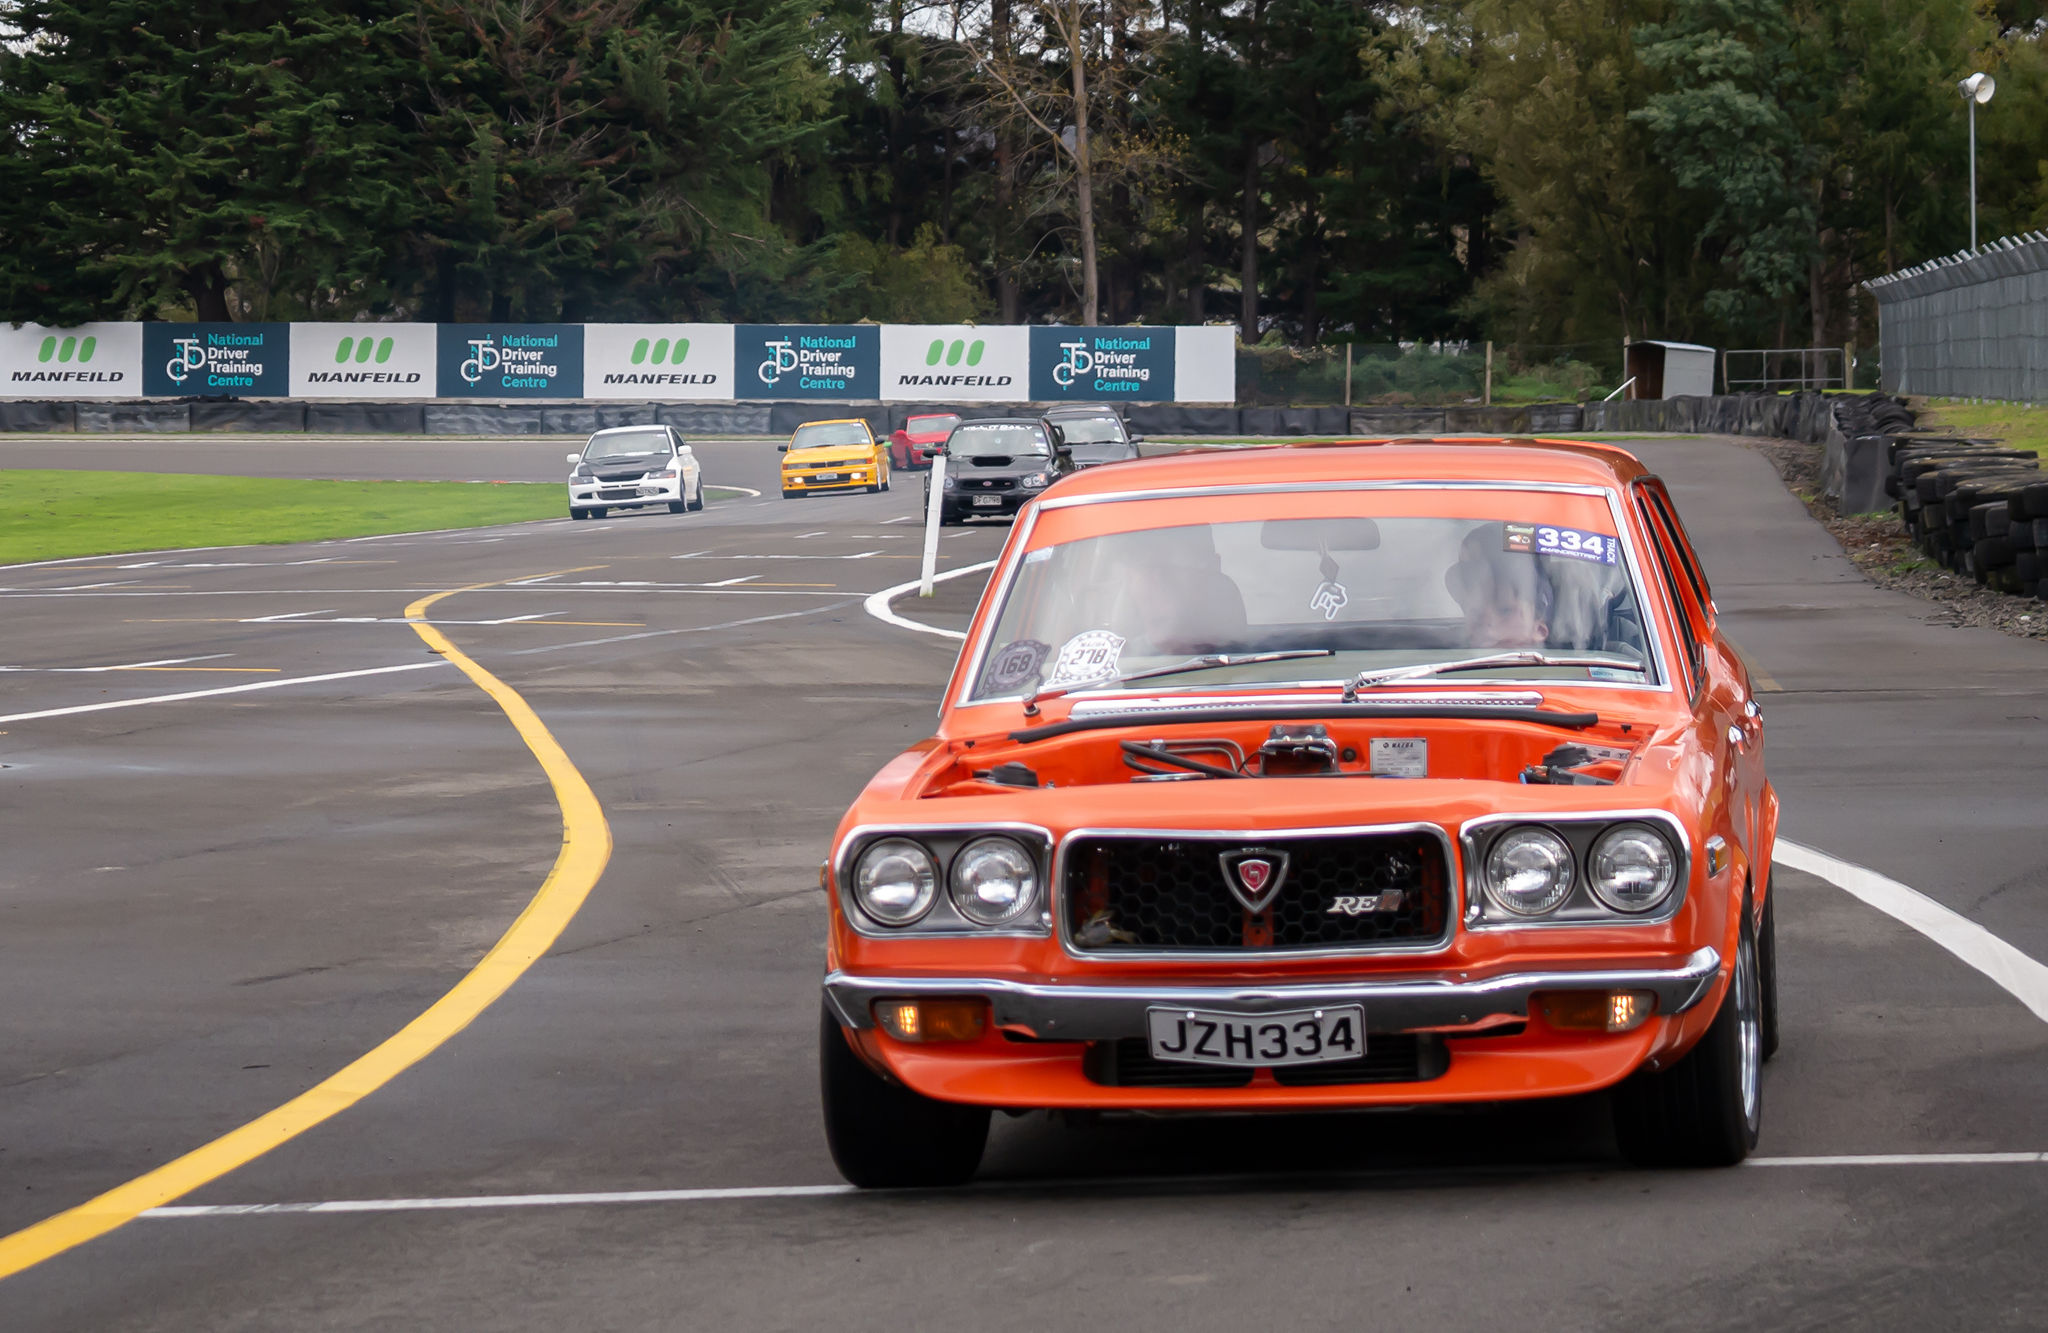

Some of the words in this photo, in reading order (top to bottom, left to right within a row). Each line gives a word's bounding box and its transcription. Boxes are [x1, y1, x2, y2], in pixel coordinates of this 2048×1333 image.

[208, 333, 263, 345] National
[502, 334, 558, 346] National
[800, 336, 855, 348] National
[1095, 337, 1150, 349] National
[208, 347, 249, 359] Driver
[502, 348, 544, 360] Driver
[800, 350, 841, 362] Driver
[1095, 351, 1136, 363] Driver
[208, 361, 263, 376] Training
[502, 362, 558, 377] Training
[800, 364, 855, 378] Training
[1095, 365, 1150, 380] Training
[11, 371, 124, 382] MANFEILD
[208, 375, 253, 386] Centre
[308, 372, 421, 383] MANFEILD
[502, 376, 548, 387] Centre
[603, 373, 717, 385] MANFEILD
[899, 375, 1012, 386] MANFEILD
[800, 378, 845, 388] Centre
[1095, 379, 1140, 390] Centre
[1538, 527, 1604, 555] 334
[1606, 538, 1616, 563] TRACK
[1070, 648, 1108, 664] 278
[999, 653, 1032, 675] 168
[1326, 895, 1378, 915] RE
[1160, 1017, 1355, 1059] JZH334
